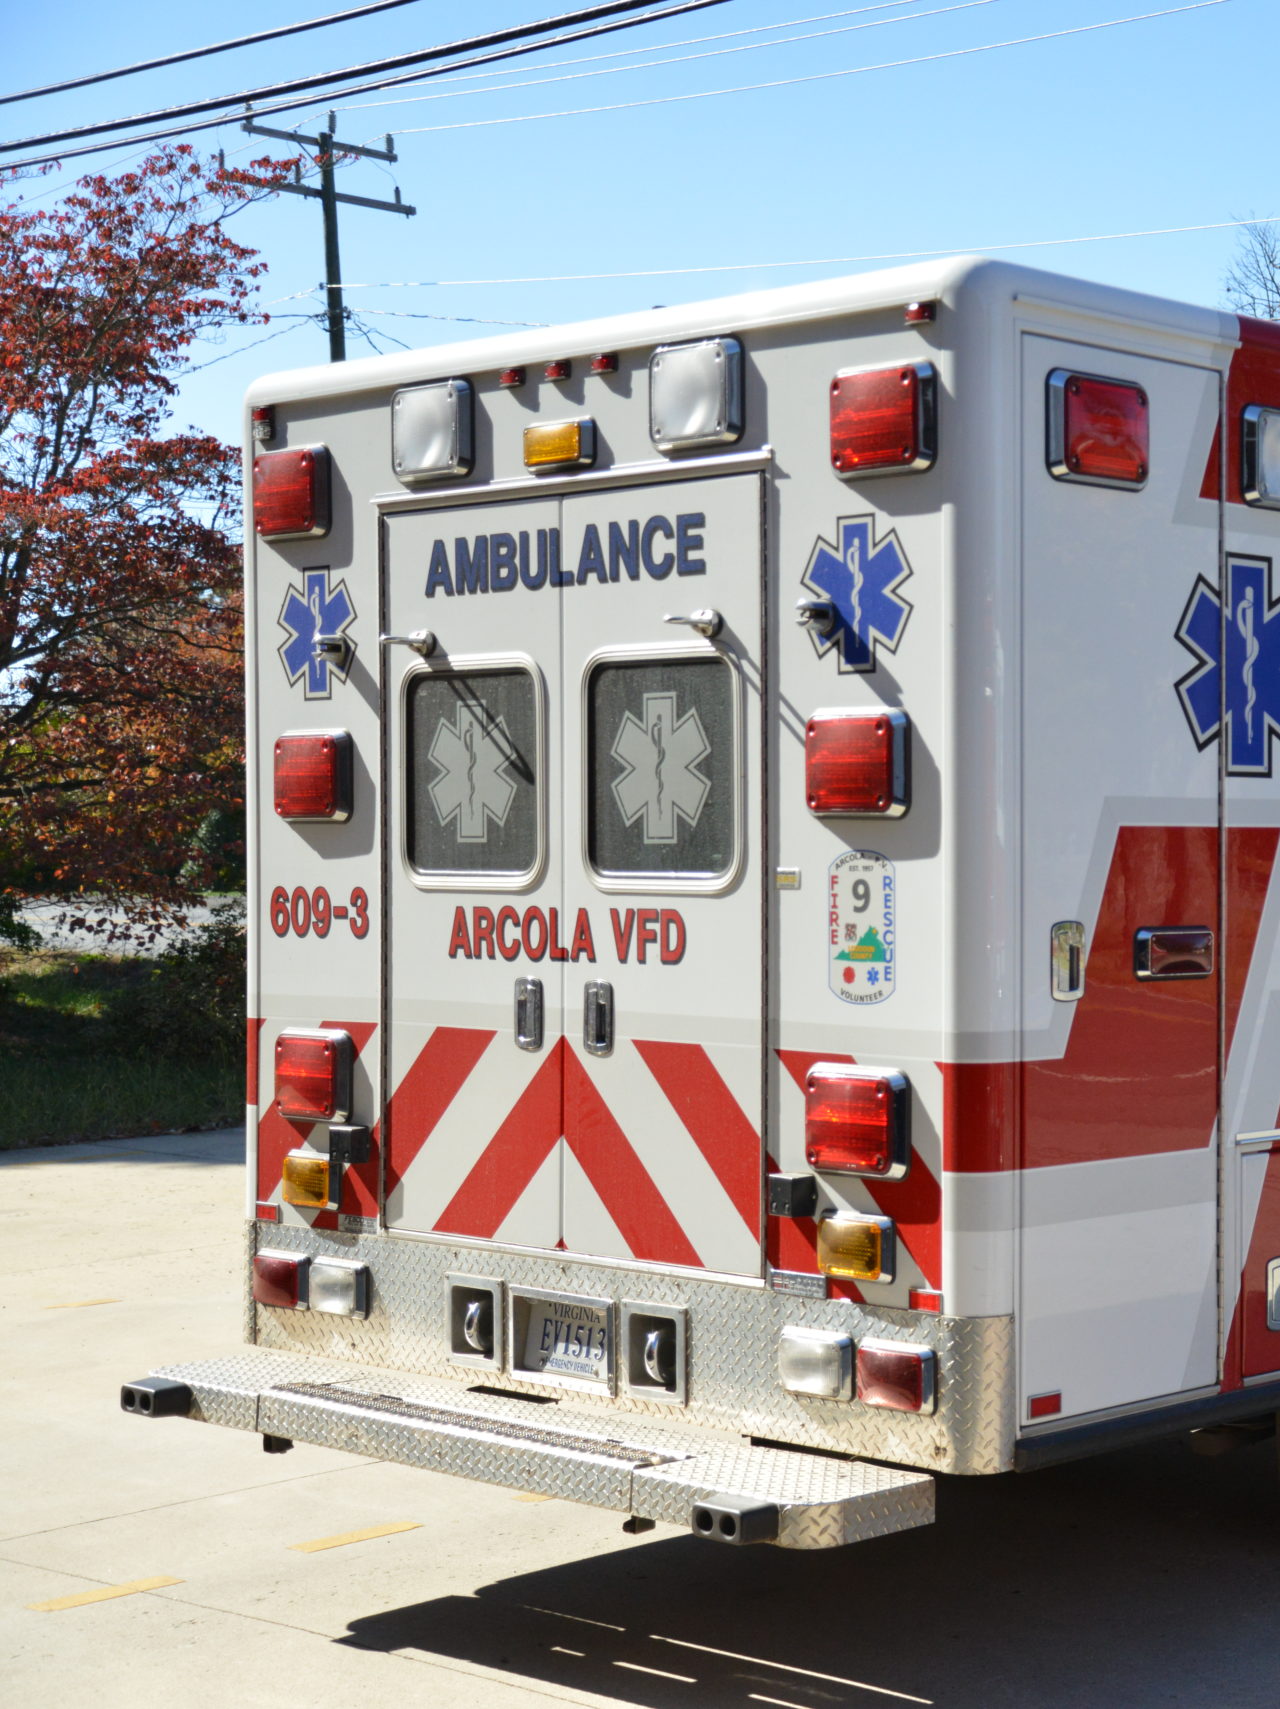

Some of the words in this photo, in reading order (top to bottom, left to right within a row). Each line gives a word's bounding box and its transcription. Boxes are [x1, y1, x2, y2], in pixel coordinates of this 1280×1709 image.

[425, 513, 706, 597] AMBULANCE
[835, 852, 865, 870] ARCOLA
[270, 885, 370, 938] 609-3
[830, 875, 840, 945] FIRE
[851, 878, 871, 914] 9
[448, 905, 595, 963] ARCOLA
[610, 907, 686, 965] VFD
[882, 875, 893, 982] RESCUE
[840, 987, 884, 1003] VOLUNTEER
[554, 1303, 600, 1323] VIRGINIA
[540, 1318, 606, 1362] EV1513
